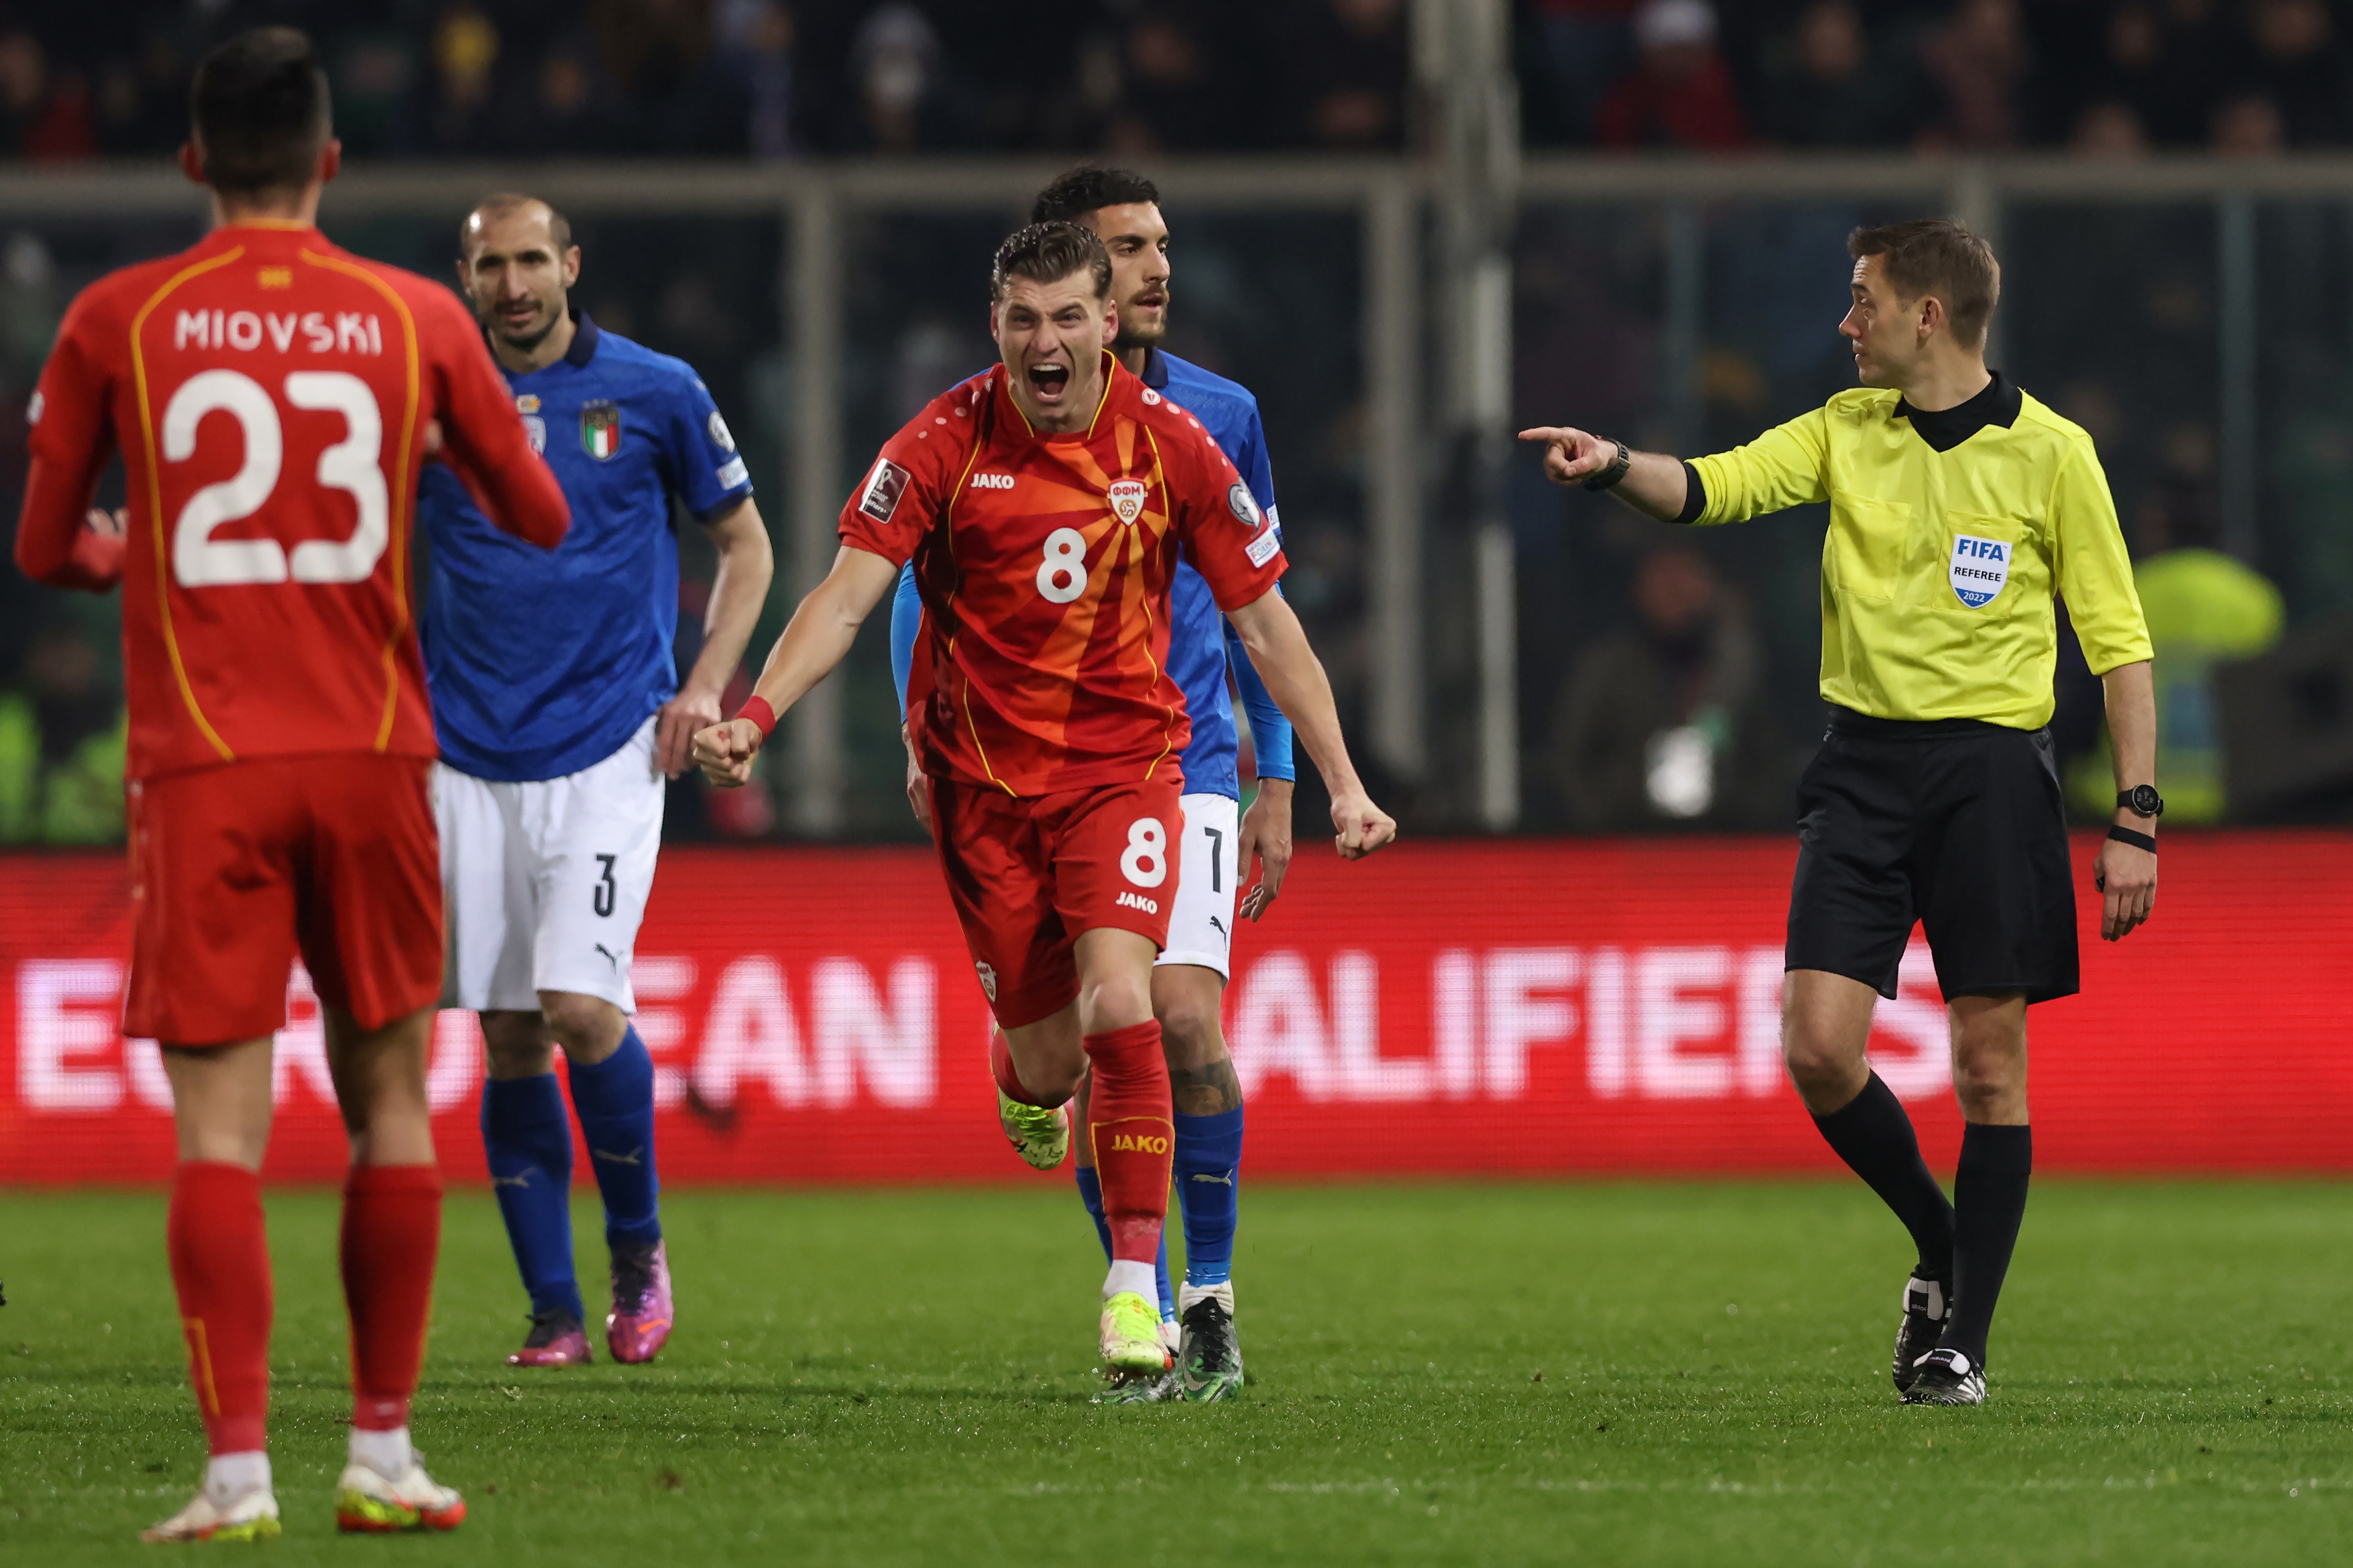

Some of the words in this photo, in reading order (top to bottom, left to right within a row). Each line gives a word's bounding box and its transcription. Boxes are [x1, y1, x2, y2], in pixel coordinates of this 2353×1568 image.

[175, 308, 382, 356] MIOVSKI
[162, 369, 389, 588] 23
[970, 473, 1015, 489] JAKO
[1958, 539, 2003, 561] FIFA
[1036, 527, 1087, 604] 8
[1954, 566, 2001, 582] REFEREE
[1963, 592, 1985, 602] 2022
[1120, 817, 1167, 888] 8
[594, 853, 617, 917] 3
[1116, 891, 1158, 915] JAKO
[1111, 1134, 1168, 1155] JAKO
